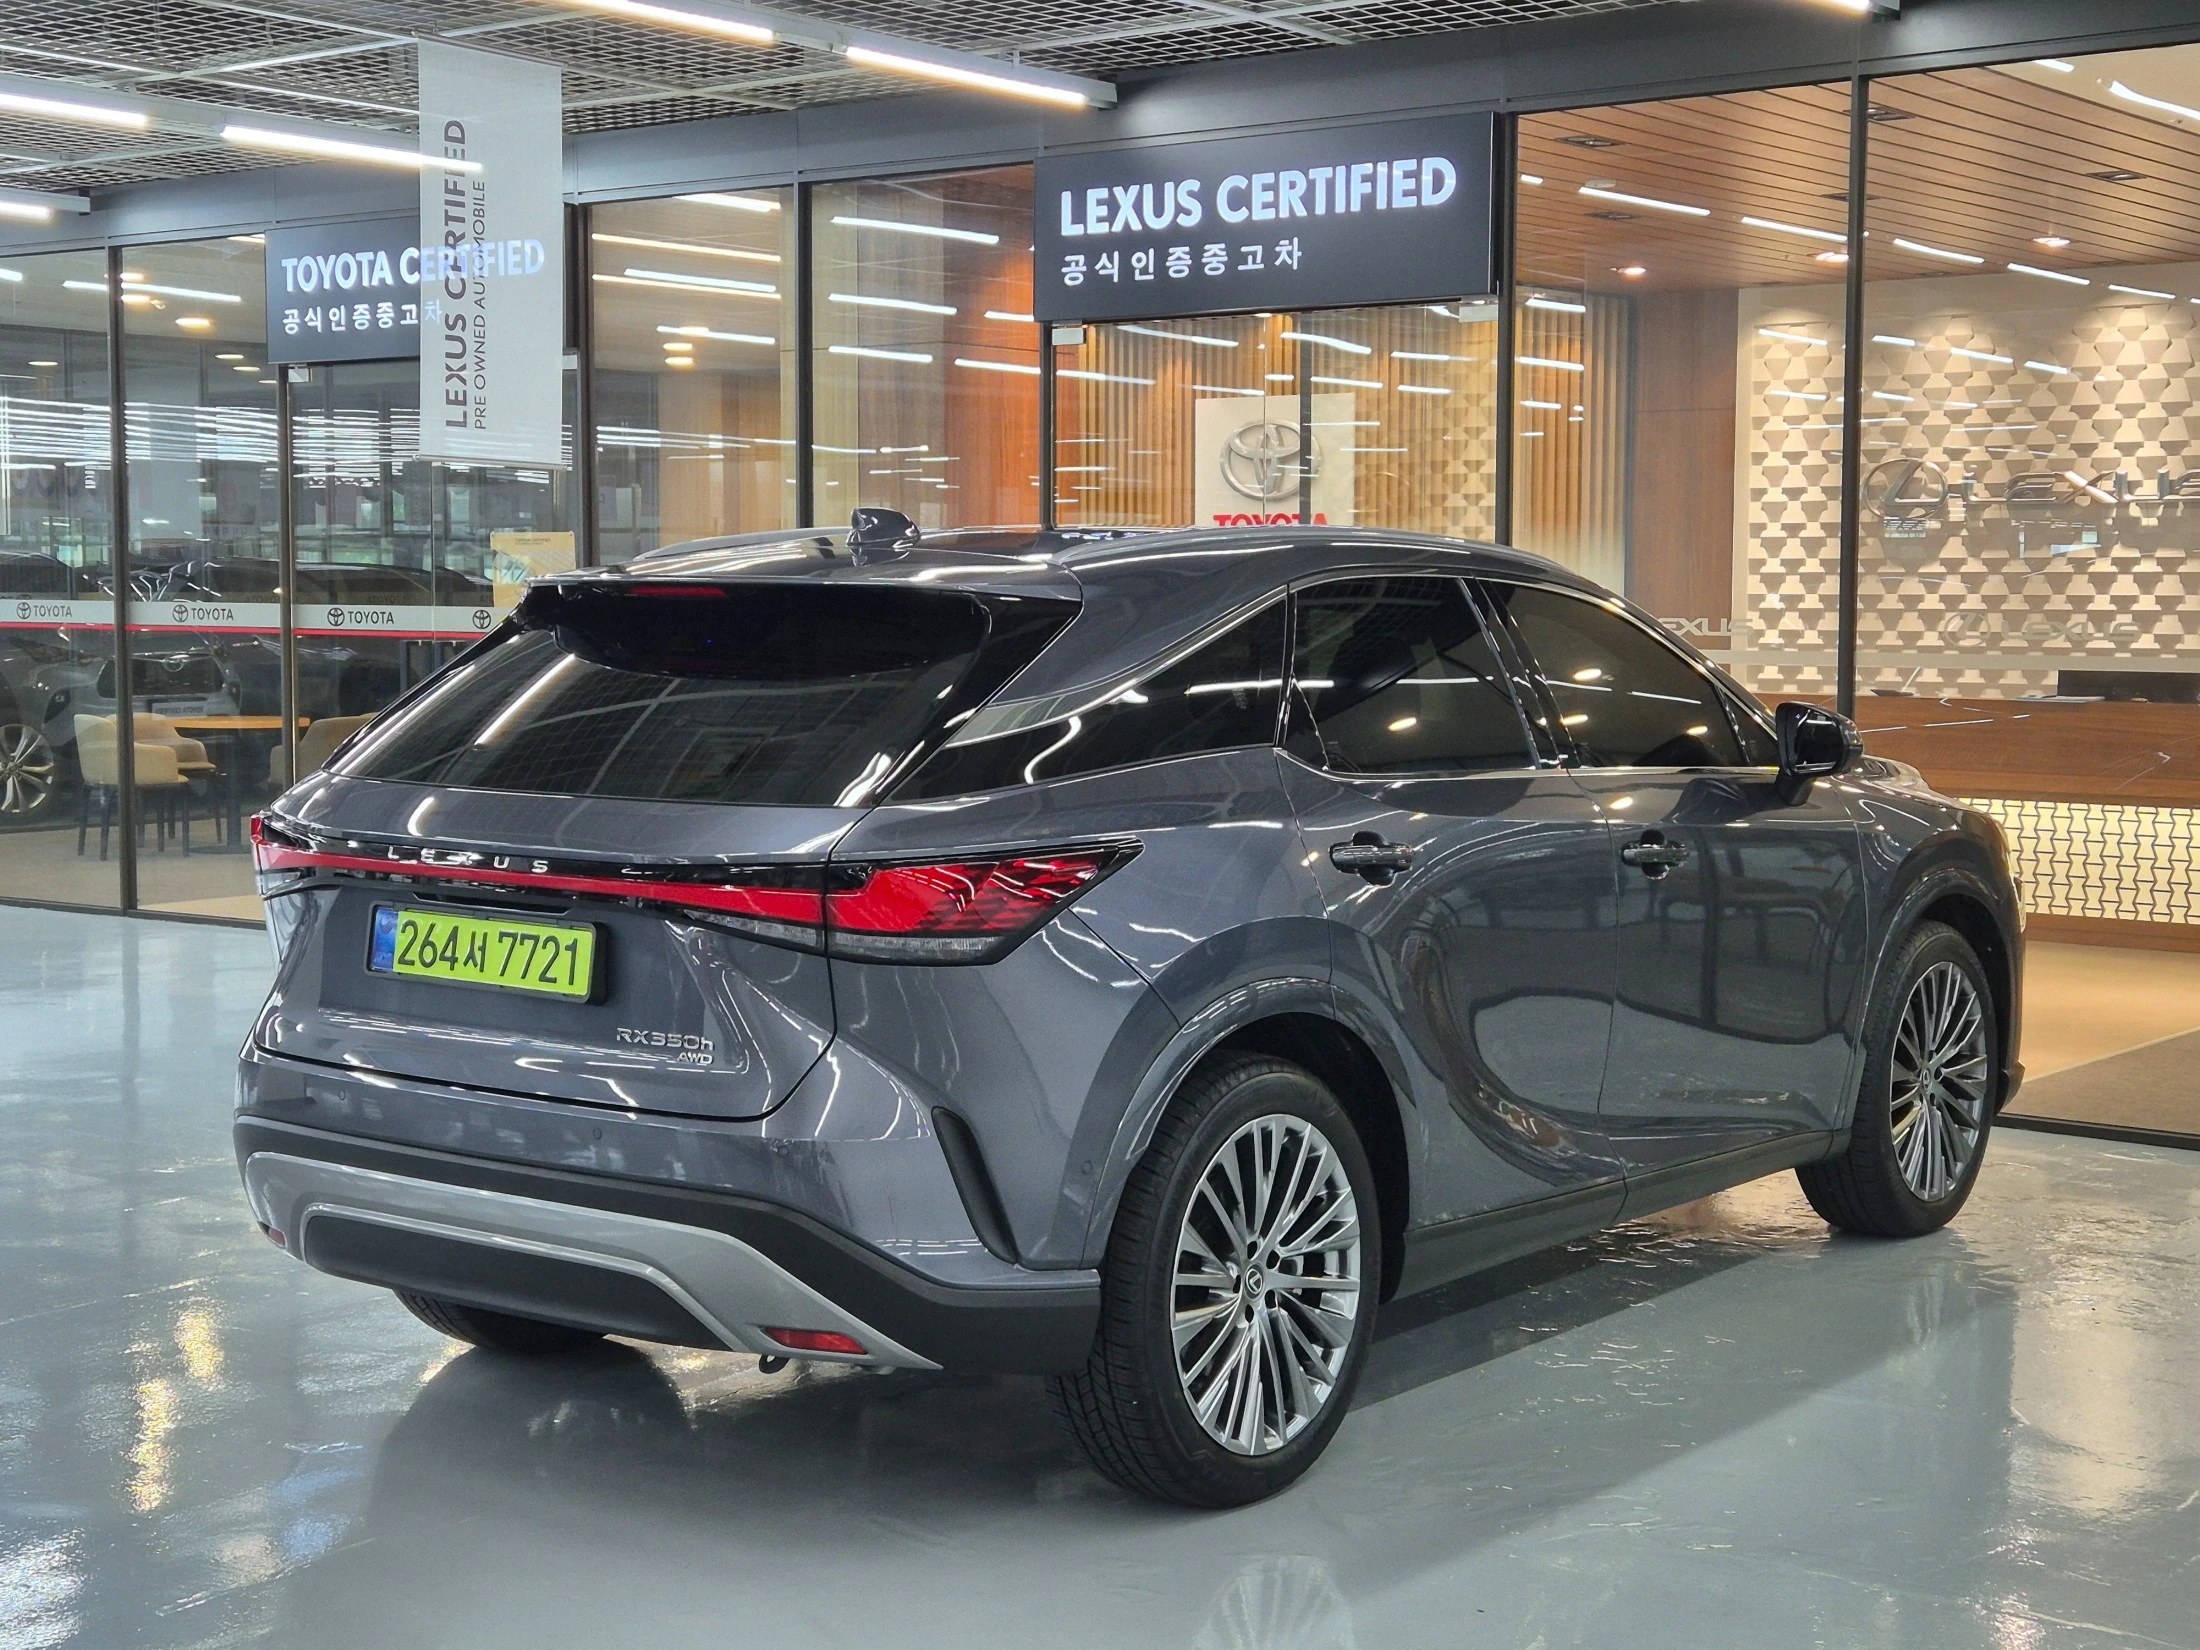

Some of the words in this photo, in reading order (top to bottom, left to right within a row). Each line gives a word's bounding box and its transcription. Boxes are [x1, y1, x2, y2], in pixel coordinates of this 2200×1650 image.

[1061, 179, 1202, 236] LEXUS
[1216, 157, 1457, 223] CERTIFIED
[281, 250, 394, 293] TOYOTA
[399, 239, 545, 285] CERTIFIED
[1061, 237, 1302, 286] 공식인증중고차
[473, 314, 486, 390] OWNED
[444, 313, 468, 428] LEXUS
[474, 396, 486, 429] PRE
[33, 605, 72, 618] TOYOTA
[191, 608, 234, 621] TOYOTA
[347, 611, 394, 625] TOYOTA
[1658, 617, 1755, 636] EXUS
[616, 1027, 714, 1051] RX350h
[677, 1052, 713, 1066] AWD
